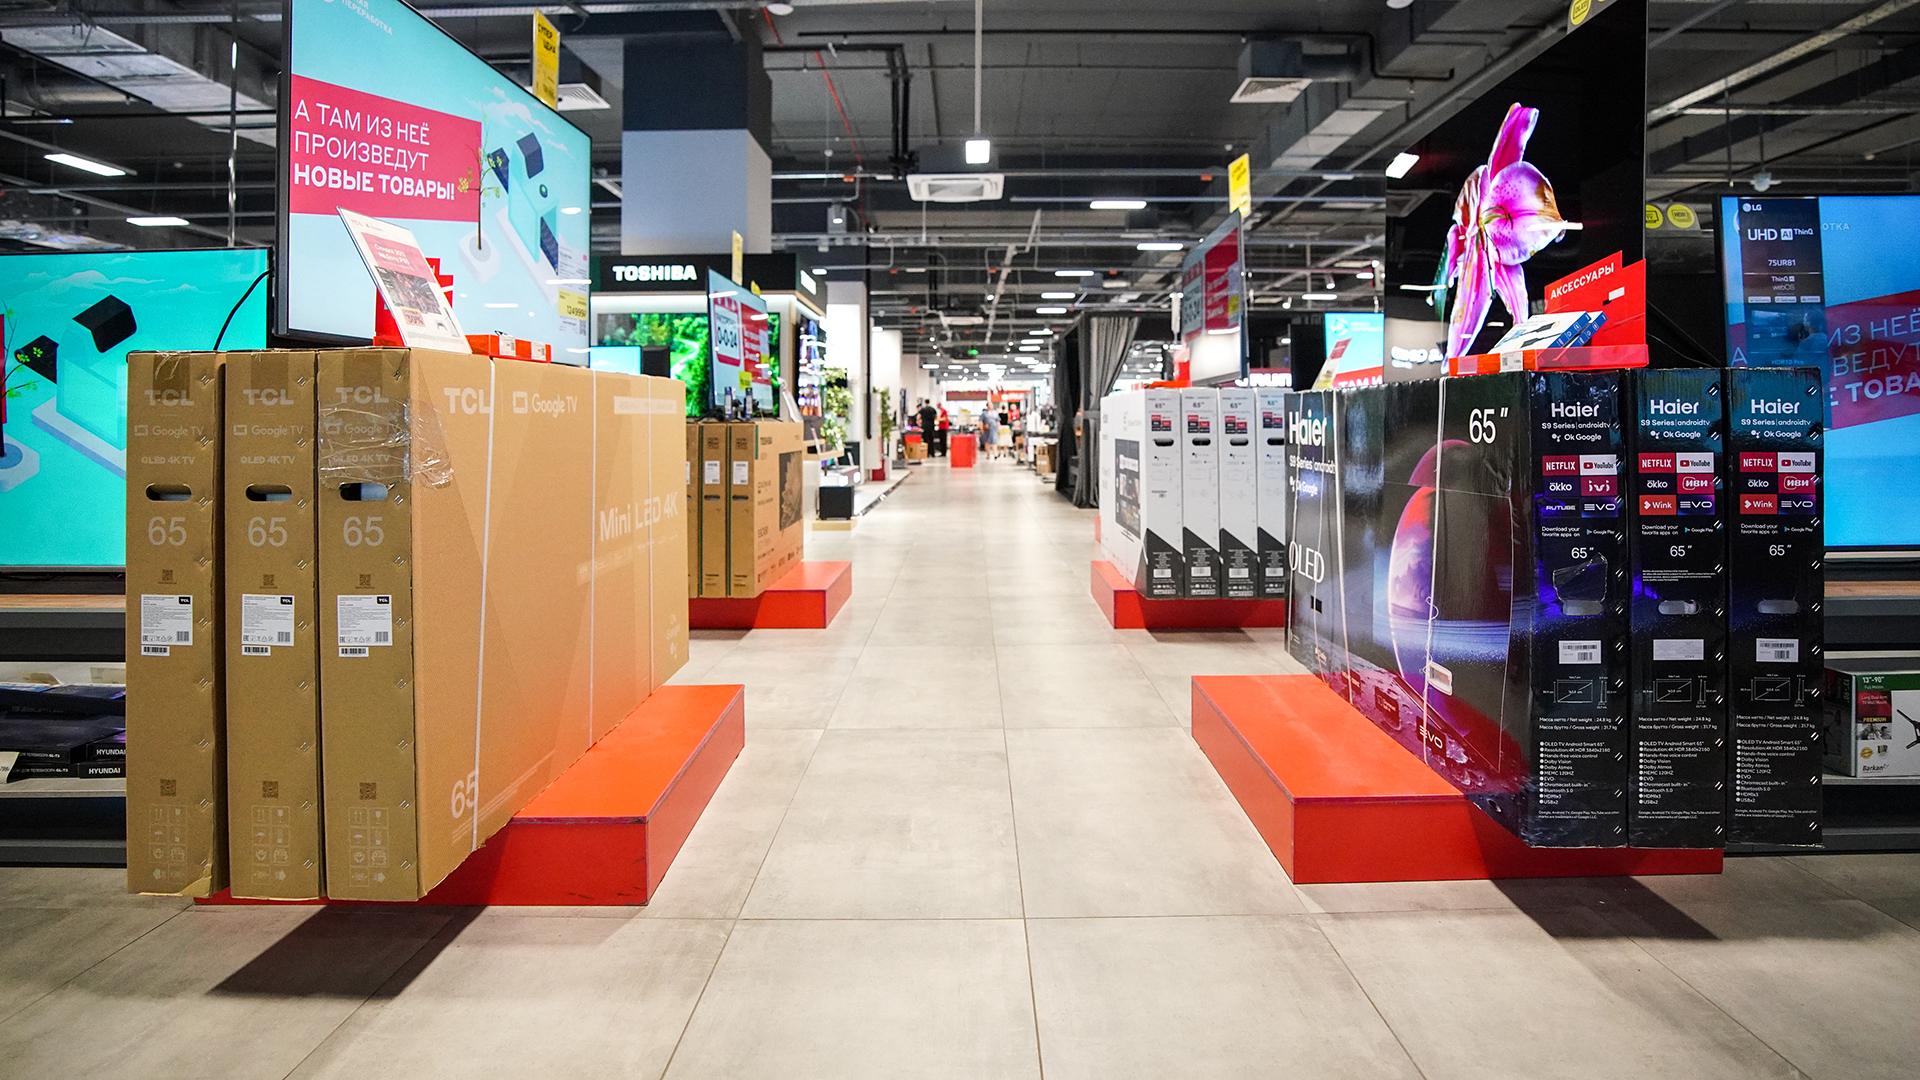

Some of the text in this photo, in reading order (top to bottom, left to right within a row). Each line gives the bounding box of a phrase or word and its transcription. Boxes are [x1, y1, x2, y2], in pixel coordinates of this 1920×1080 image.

[295, 99, 430, 145] А ТАМ ИЗ НЕЁ
[295, 131, 429, 172] ПРОИЗВЕДУТ
[294, 163, 455, 200] НОВЫЕ ТОВАРЫ!
[1748, 229, 1778, 241] UHD
[1793, 228, 1814, 236] ThinQ
[1768, 259, 1797, 267] 75UR81
[612, 265, 698, 281] TOSHIBA
[1550, 262, 1615, 300] АКСЕССУАРЫ
[1731, 347, 1748, 366] А
[144, 388, 195, 407] TCL
[243, 388, 294, 406] TCL
[336, 386, 389, 404] TCL
[444, 387, 491, 415] TCL
[531, 392, 577, 418] Google TV
[1551, 401, 1600, 418] Haier
[1650, 399, 1699, 415] Haier
[1751, 398, 1800, 414] Haier
[1289, 409, 1328, 447] Haier
[1640, 419, 1651, 427] S9
[1741, 418, 1751, 426] S9
[1752, 418, 1776, 426] Series
[152, 425, 204, 439] Google TV
[251, 424, 303, 438] Google TV
[344, 423, 383, 438] Google
[1575, 433, 1602, 442] Google
[1674, 431, 1701, 440] Google
[1763, 430, 1802, 439] Ok Google
[167, 456, 181, 465] 4K
[182, 456, 195, 465] TV
[267, 456, 280, 465] 4K
[281, 456, 295, 465] TV
[360, 453, 375, 464] 4K
[376, 453, 390, 464] TV
[1546, 461, 1576, 471] NETFLIX
[1593, 461, 1614, 470] YouTube
[1642, 459, 1672, 468] NETFLIX
[1690, 460, 1711, 468] YouTube
[1743, 458, 1773, 467] NETFLIX
[1303, 480, 1319, 497] Google
[1652, 501, 1673, 509] Wink
[1752, 500, 1773, 508] Wink
[599, 491, 680, 542] Mini LED 4K
[148, 516, 187, 546] 65
[247, 516, 288, 547] 65
[343, 516, 385, 547] 65
[1288, 541, 1325, 583] OLED
[88, 767, 121, 775] HYUNDAI
[451, 770, 479, 819] 65
